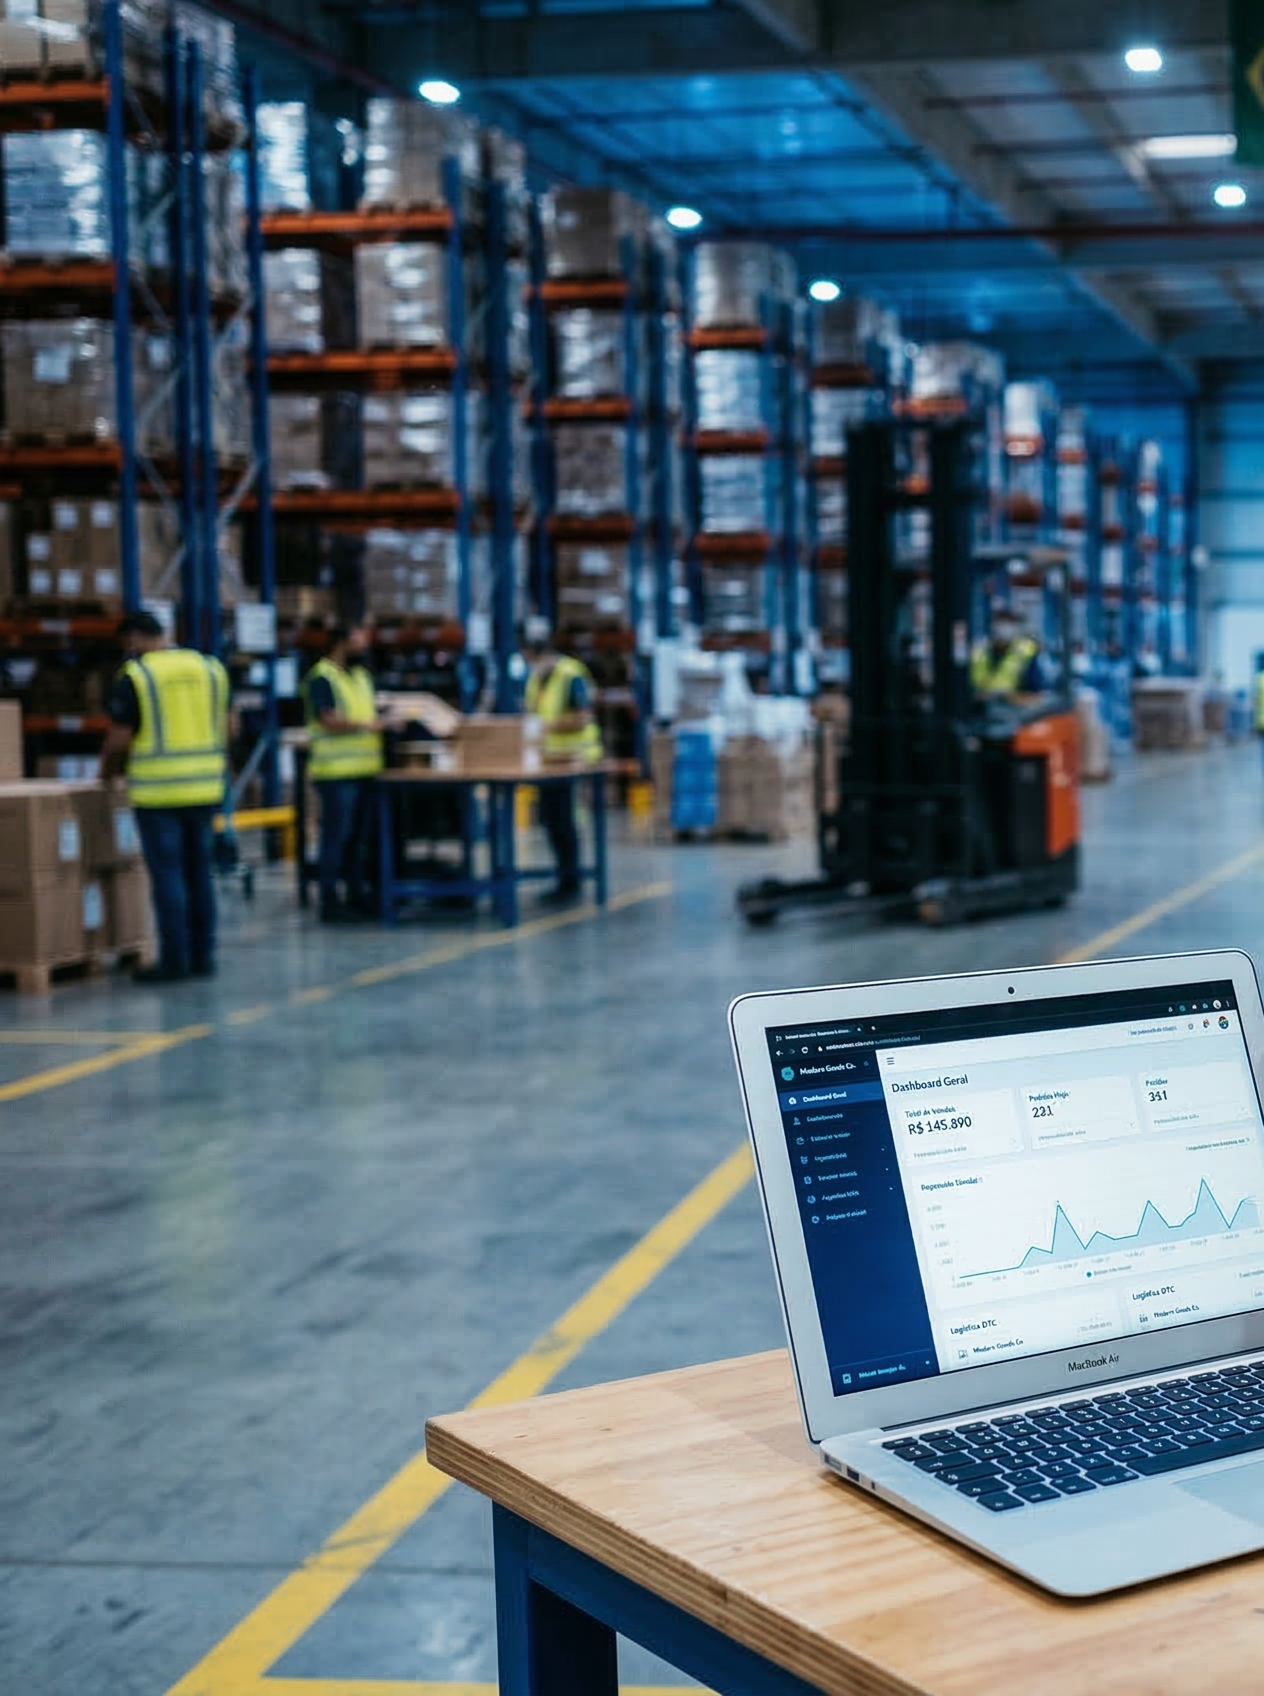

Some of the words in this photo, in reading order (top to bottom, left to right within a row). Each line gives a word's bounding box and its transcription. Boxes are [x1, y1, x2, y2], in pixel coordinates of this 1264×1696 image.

[891, 1076, 942, 1093] Dashboard
[943, 1074, 969, 1087] Geral
[908, 1121, 924, 1135] R$
[926, 1116, 972, 1132] 145.890
[1068, 1355, 1107, 1372] MacBook
[1109, 1353, 1120, 1363] Air
